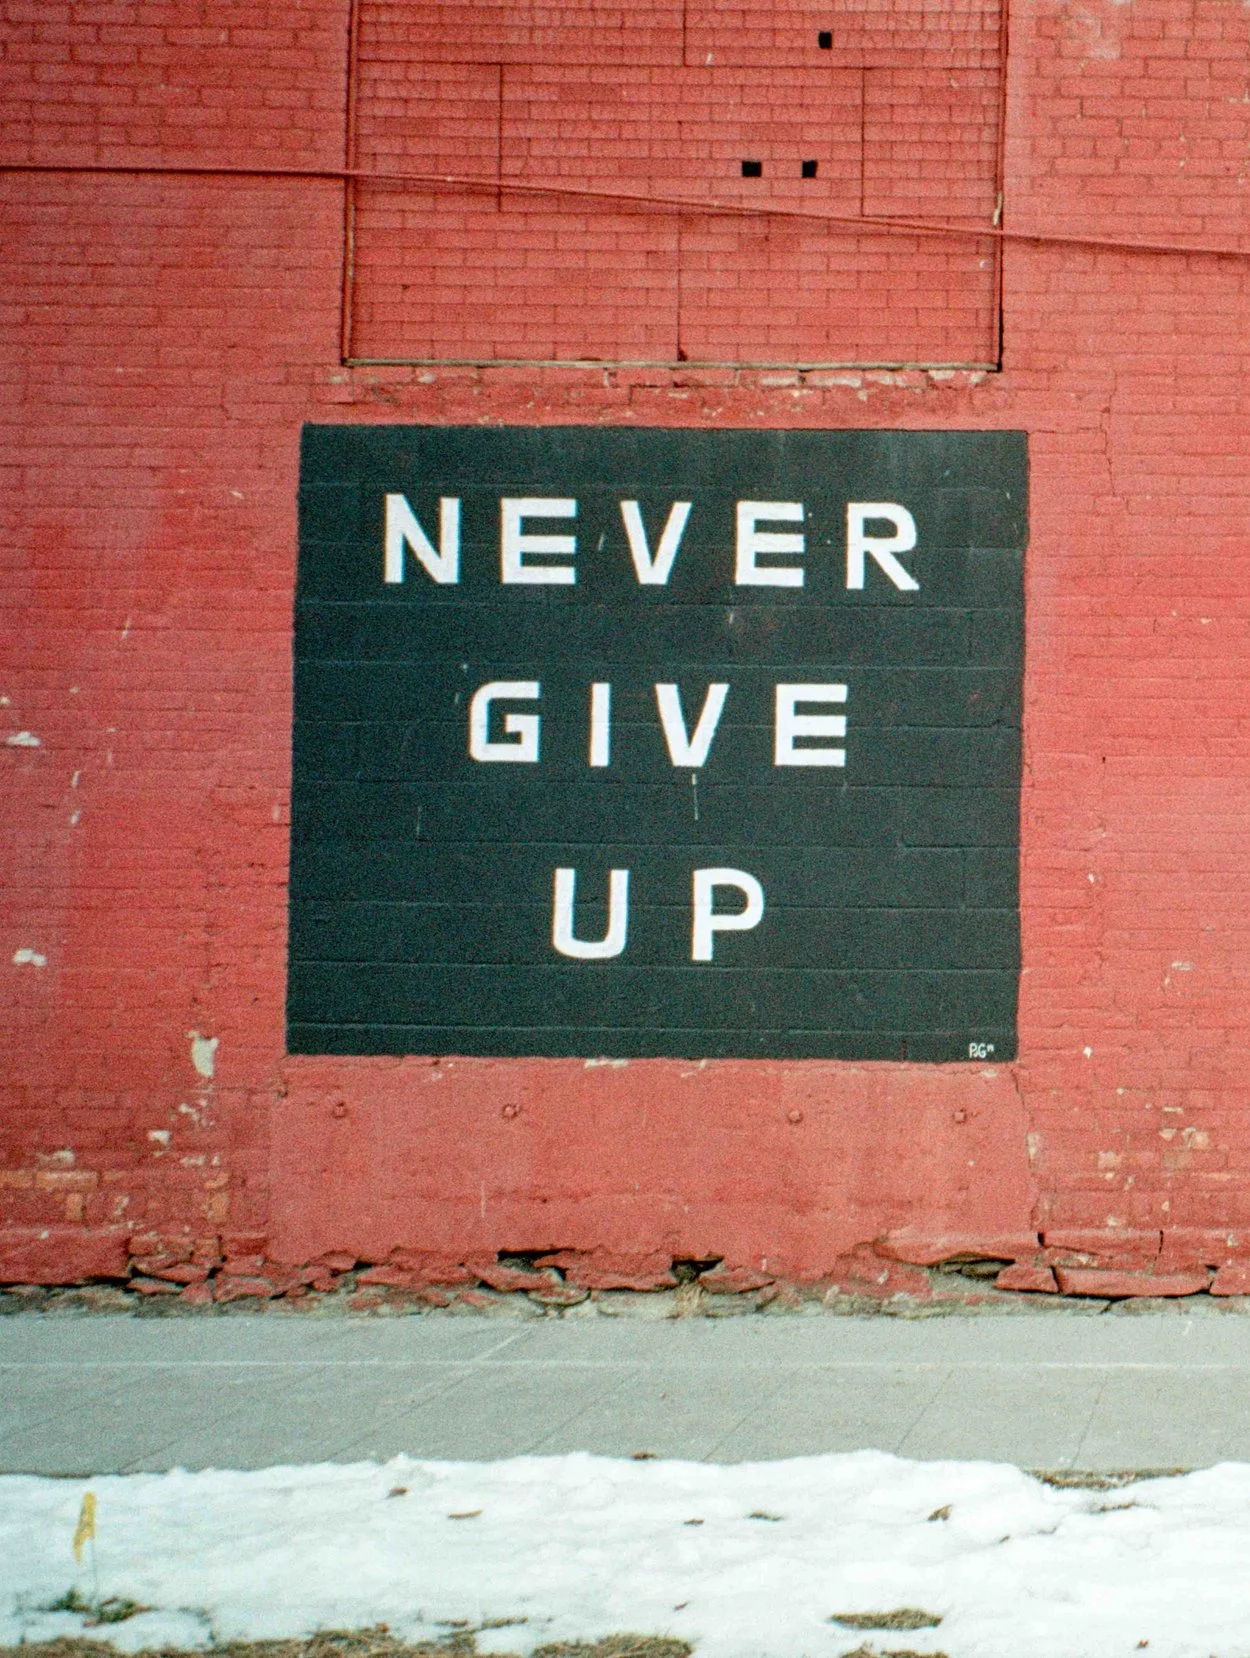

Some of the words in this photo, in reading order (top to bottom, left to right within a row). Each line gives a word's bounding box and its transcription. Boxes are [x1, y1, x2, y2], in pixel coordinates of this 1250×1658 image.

[385, 494, 920, 590] NEVER
[470, 681, 849, 768] GIVE
[552, 868, 765, 961] UP
